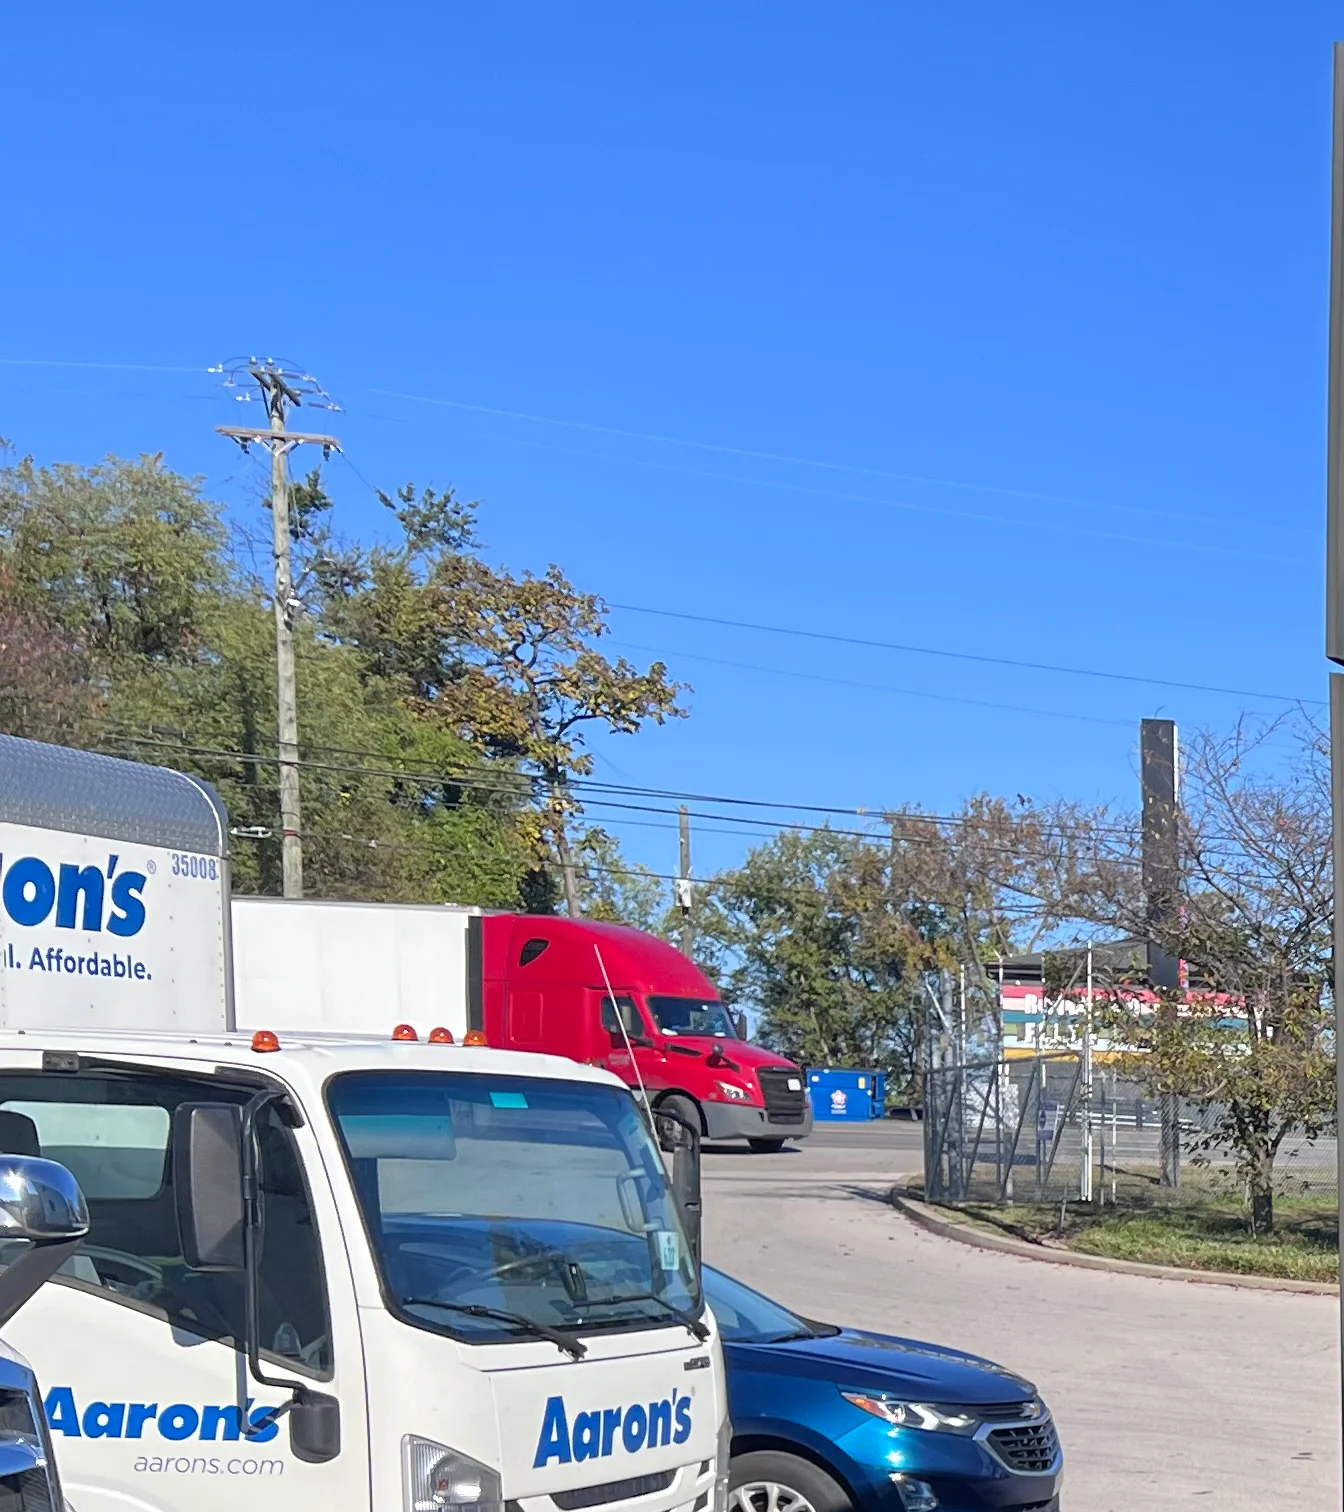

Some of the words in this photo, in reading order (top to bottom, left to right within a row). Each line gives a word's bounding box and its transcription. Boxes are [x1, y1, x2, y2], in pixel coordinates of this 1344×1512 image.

[171, 852, 217, 881] 35008
[0, 853, 147, 938] on's
[29, 946, 152, 981] Affordable.
[43, 1386, 280, 1443] Aaron's
[532, 1387, 692, 1469] Aaron's
[133, 1456, 284, 1476] aarons.com
